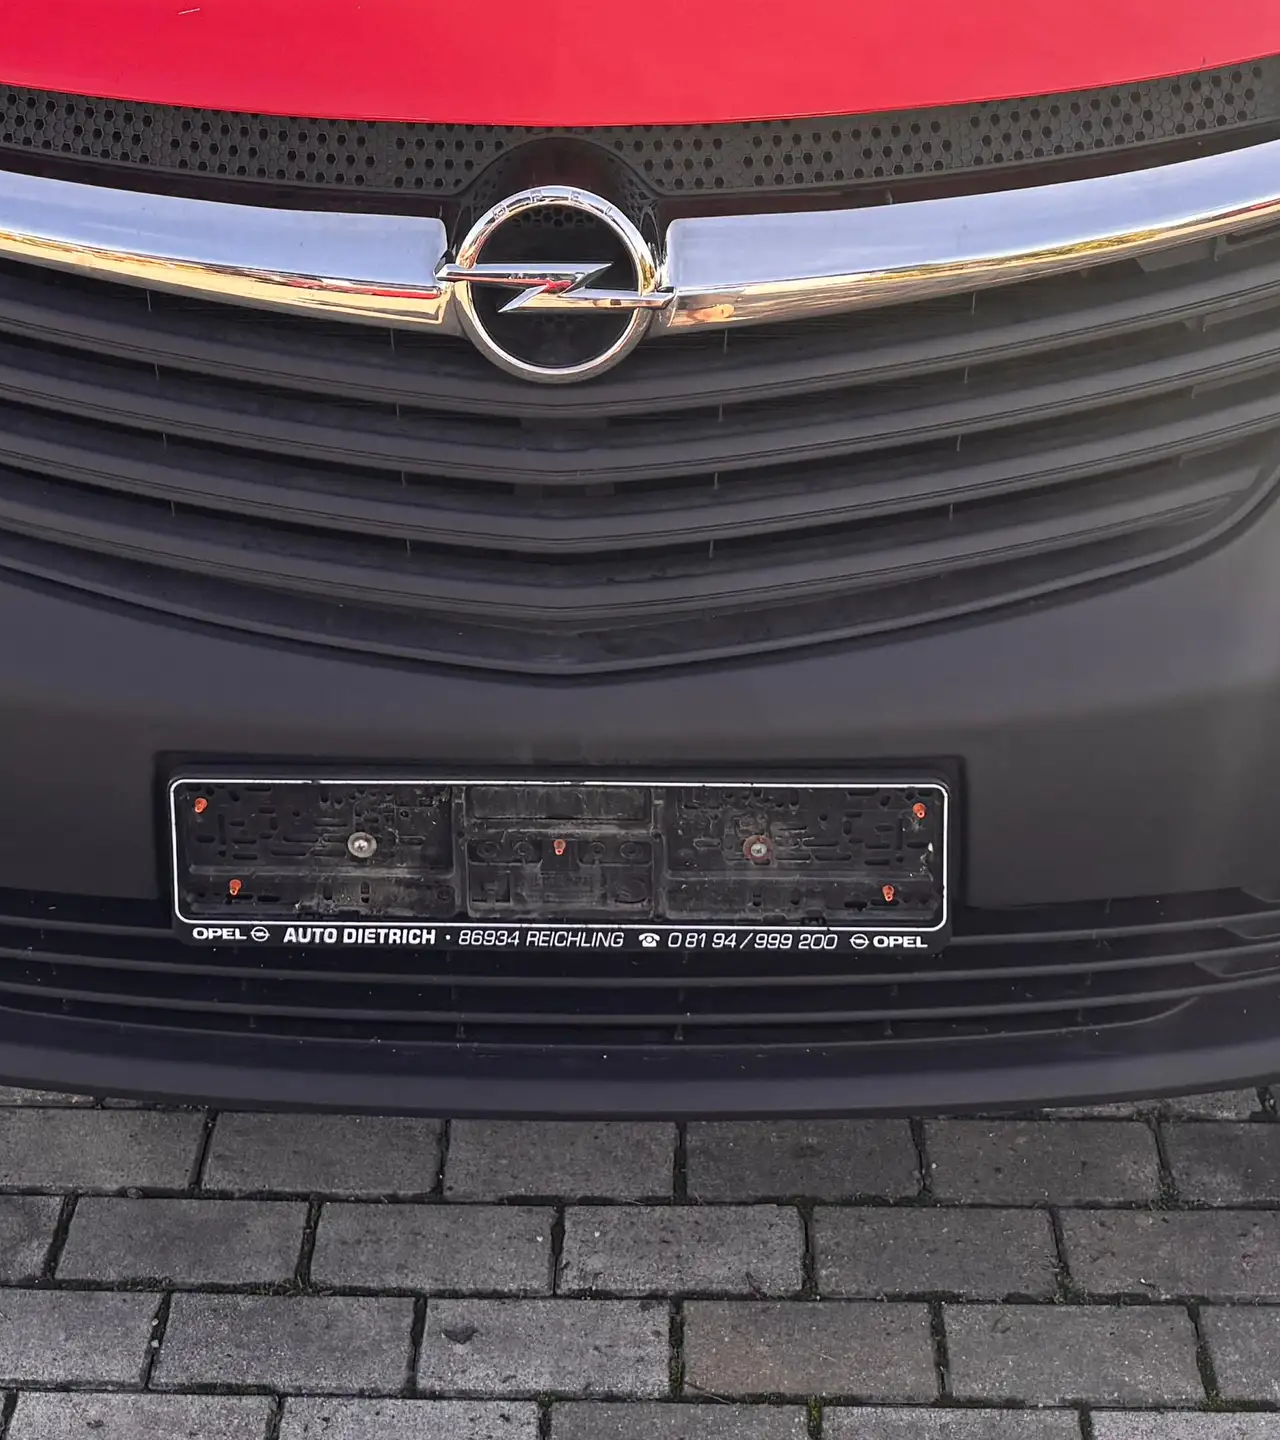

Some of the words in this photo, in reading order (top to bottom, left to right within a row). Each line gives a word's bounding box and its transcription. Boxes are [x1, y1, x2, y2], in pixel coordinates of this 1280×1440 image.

[492, 190, 614, 221] OPEL
[192, 926, 248, 941] OPEL
[283, 927, 338, 944] AUTO
[342, 928, 436, 945] DIETRICH
[458, 929, 521, 947] 86934
[525, 930, 625, 948] REICHLING
[797, 933, 838, 950] 200
[872, 935, 929, 949] OPEL
